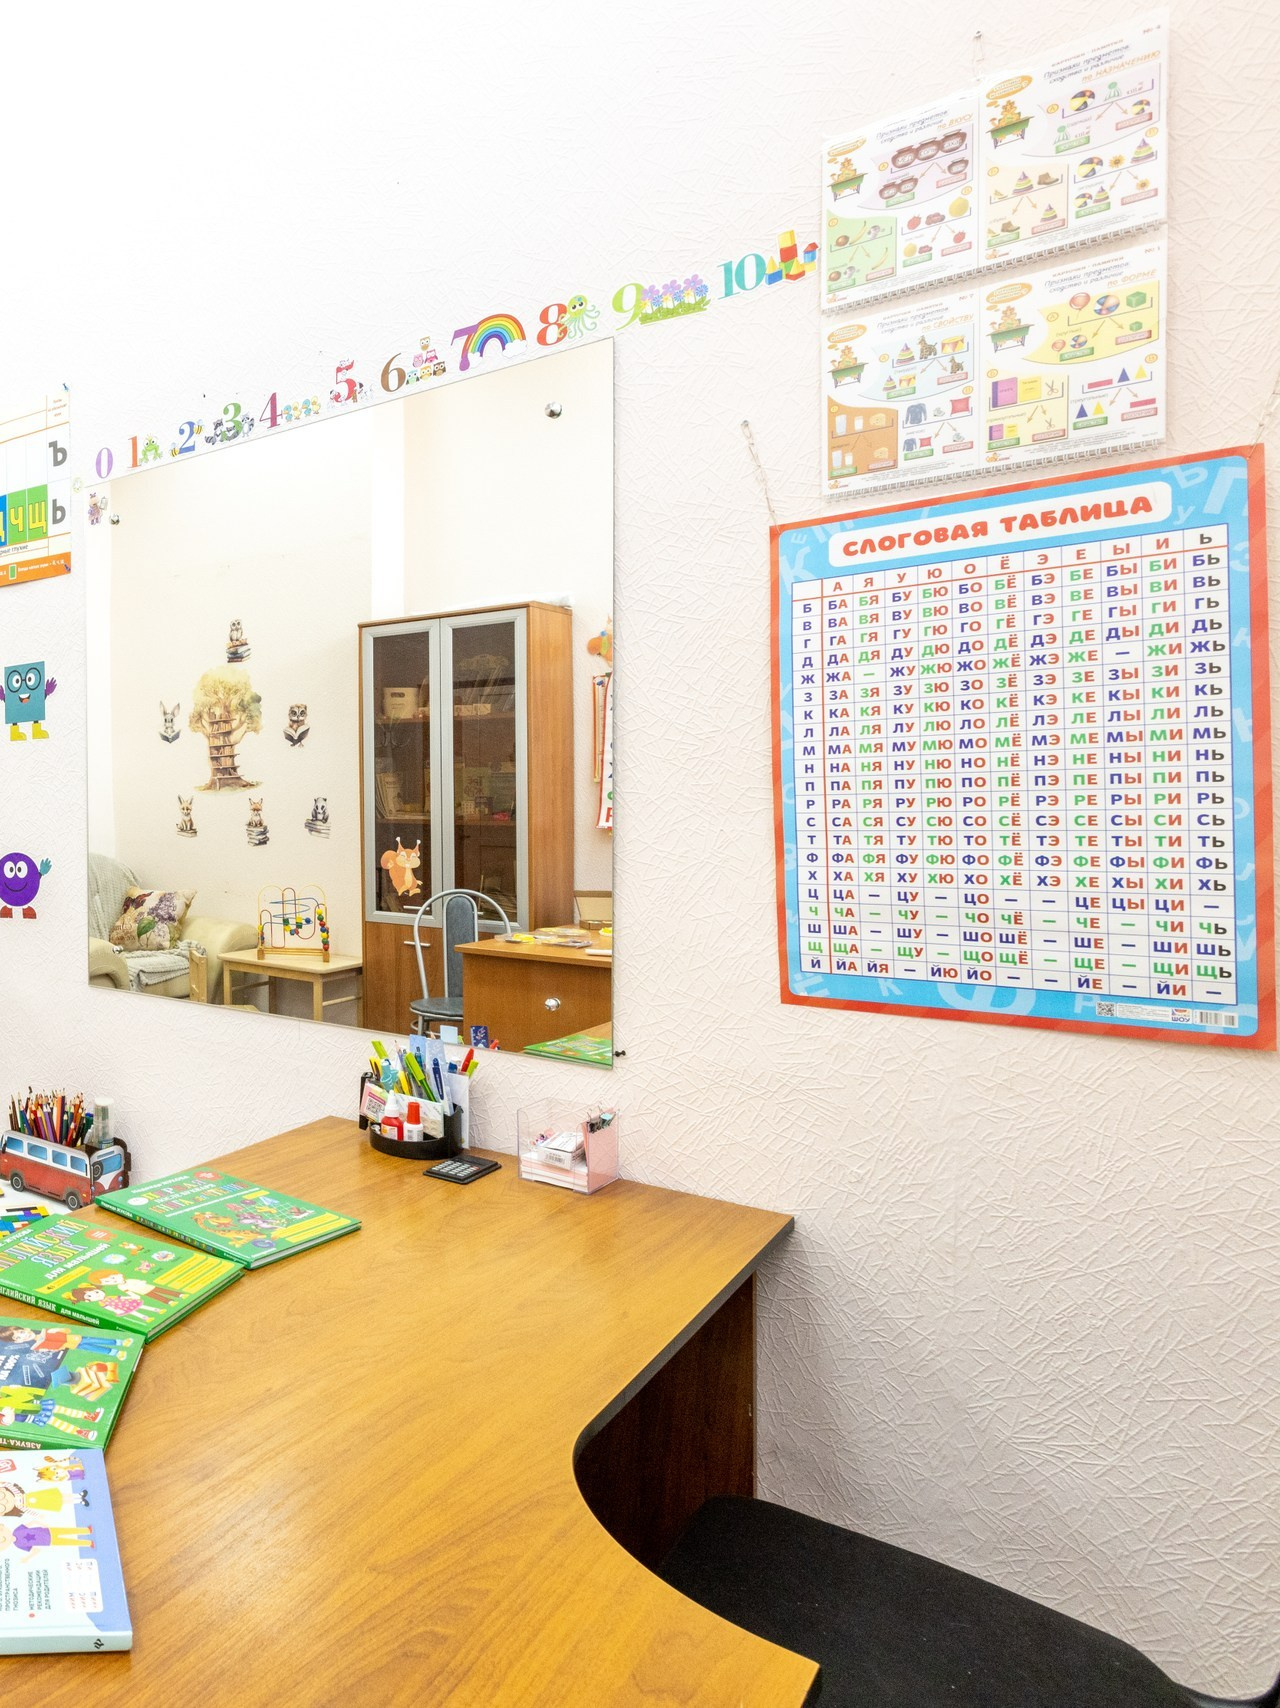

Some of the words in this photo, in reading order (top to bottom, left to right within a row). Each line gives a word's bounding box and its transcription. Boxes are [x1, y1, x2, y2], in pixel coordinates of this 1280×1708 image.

[95, 447, 113, 479] 0
[127, 436, 141, 468] 1
[179, 421, 196, 454] 2
[222, 402, 243, 442] 3
[259, 392, 283, 429] 4
[335, 363, 355, 403] 5
[380, 353, 407, 393] 6
[450, 322, 481, 372] 7
[536, 303, 568, 346] 8
[611, 282, 645, 332] 9
[717, 253, 767, 300] 10
[48, 440, 67, 467] ъ
[842, 520, 989, 558] СЛОГОВАЯ
[1001, 495, 1153, 535] ТАБЛИЦА
[803, 603, 812, 613] Б
[828, 599, 848, 610] БА
[859, 595, 879, 606] БЯ
[892, 591, 912, 603] БУ
[922, 586, 948, 599] БЮ
[959, 582, 983, 594] БО
[995, 575, 1016, 590] БЁ
[1031, 573, 1055, 586] БЭ
[1070, 568, 1093, 581] БЕ
[1106, 563, 1138, 577] БЫ
[1149, 558, 1177, 572] БИ
[1192, 554, 1220, 567] БЬ
[833, 582, 843, 592] А
[863, 577, 874, 588] Я
[897, 573, 907, 584] У
[927, 568, 942, 579] Ю
[964, 563, 976, 574] О
[1000, 556, 1010, 570] Ё
[1037, 554, 1049, 565] Э
[1076, 549, 1086, 560] Е
[1113, 543, 1130, 556] Ы
[1156, 538, 1170, 550] И
[1200, 534, 1212, 544] Ь
[31, 1239, 88, 1268] ЯЗЫК
[44, 1268, 66, 1280] для
[64, 1242, 110, 1268] малышей
[38, 1300, 56, 1312] ЯЗЫК
[60, 1307, 71, 1315] для
[72, 1311, 100, 1325] малышей
